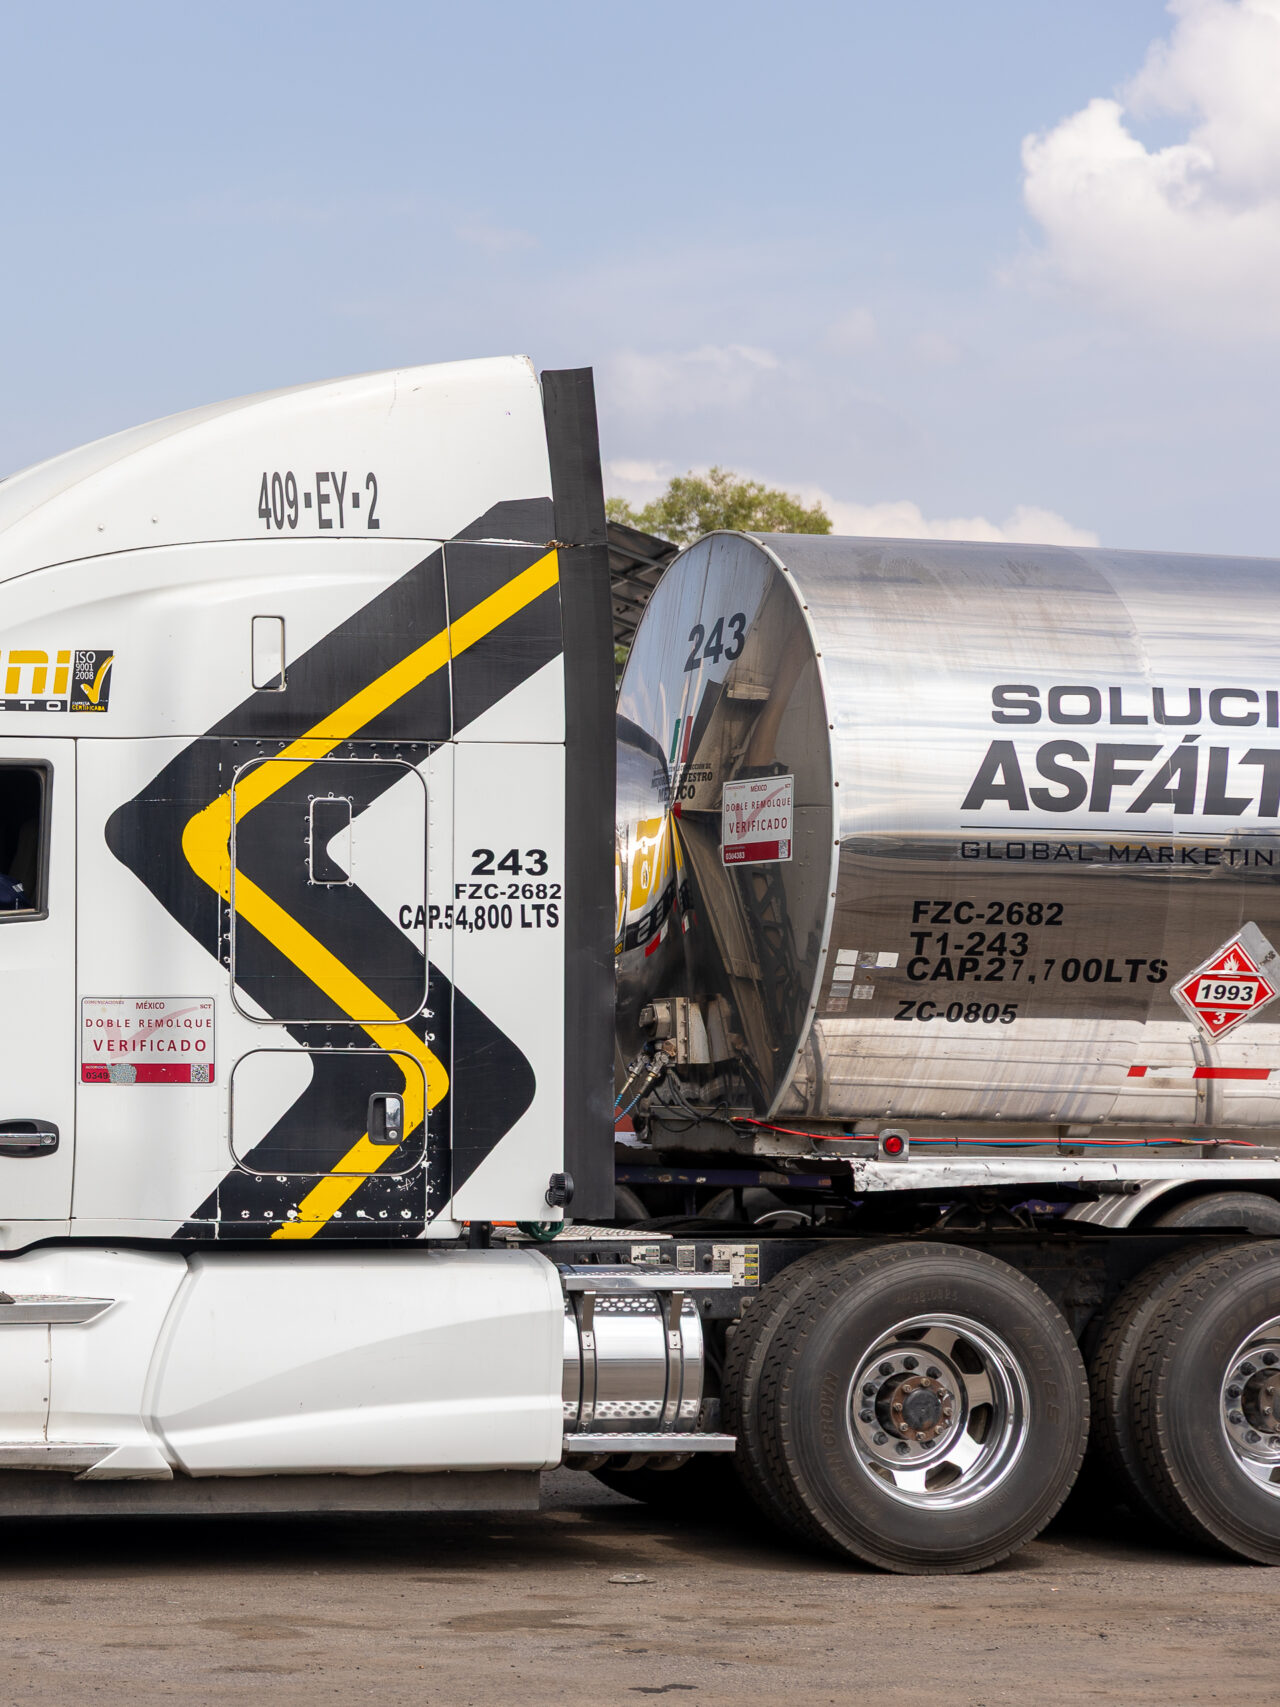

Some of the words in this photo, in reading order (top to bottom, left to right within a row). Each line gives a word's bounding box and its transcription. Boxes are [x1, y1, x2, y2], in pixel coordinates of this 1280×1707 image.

[258, 471, 380, 530] 409-EY-2
[683, 612, 746, 672] 243
[75, 651, 96, 663] ISO
[75, 663, 94, 671] 9001
[75, 672, 94, 680] 2008
[991, 684, 1278, 728] SOLUCI
[725, 802, 748, 813] DOBLE
[751, 797, 791, 809] REMOLQUE
[729, 817, 788, 834] VERIFICADO
[471, 848, 549, 876] 243
[961, 841, 1093, 861] GLOBAL
[1109, 844, 1273, 866] MARKETIN
[455, 883, 562, 900] FZC-2682
[520, 903, 559, 929] LTS
[912, 900, 1064, 926] FZC-2682
[910, 931, 1029, 957] T1-243
[1201, 984, 1253, 1001] 1993
[136, 1000, 165, 1010] MÉXICO
[894, 1000, 1018, 1024] ZC-0805
[85, 1019, 131, 1028] DOBLE
[138, 1019, 212, 1029] REMOLQUE
[1213, 1011, 1226, 1025] 3
[93, 1039, 206, 1052] VERIFICADO
